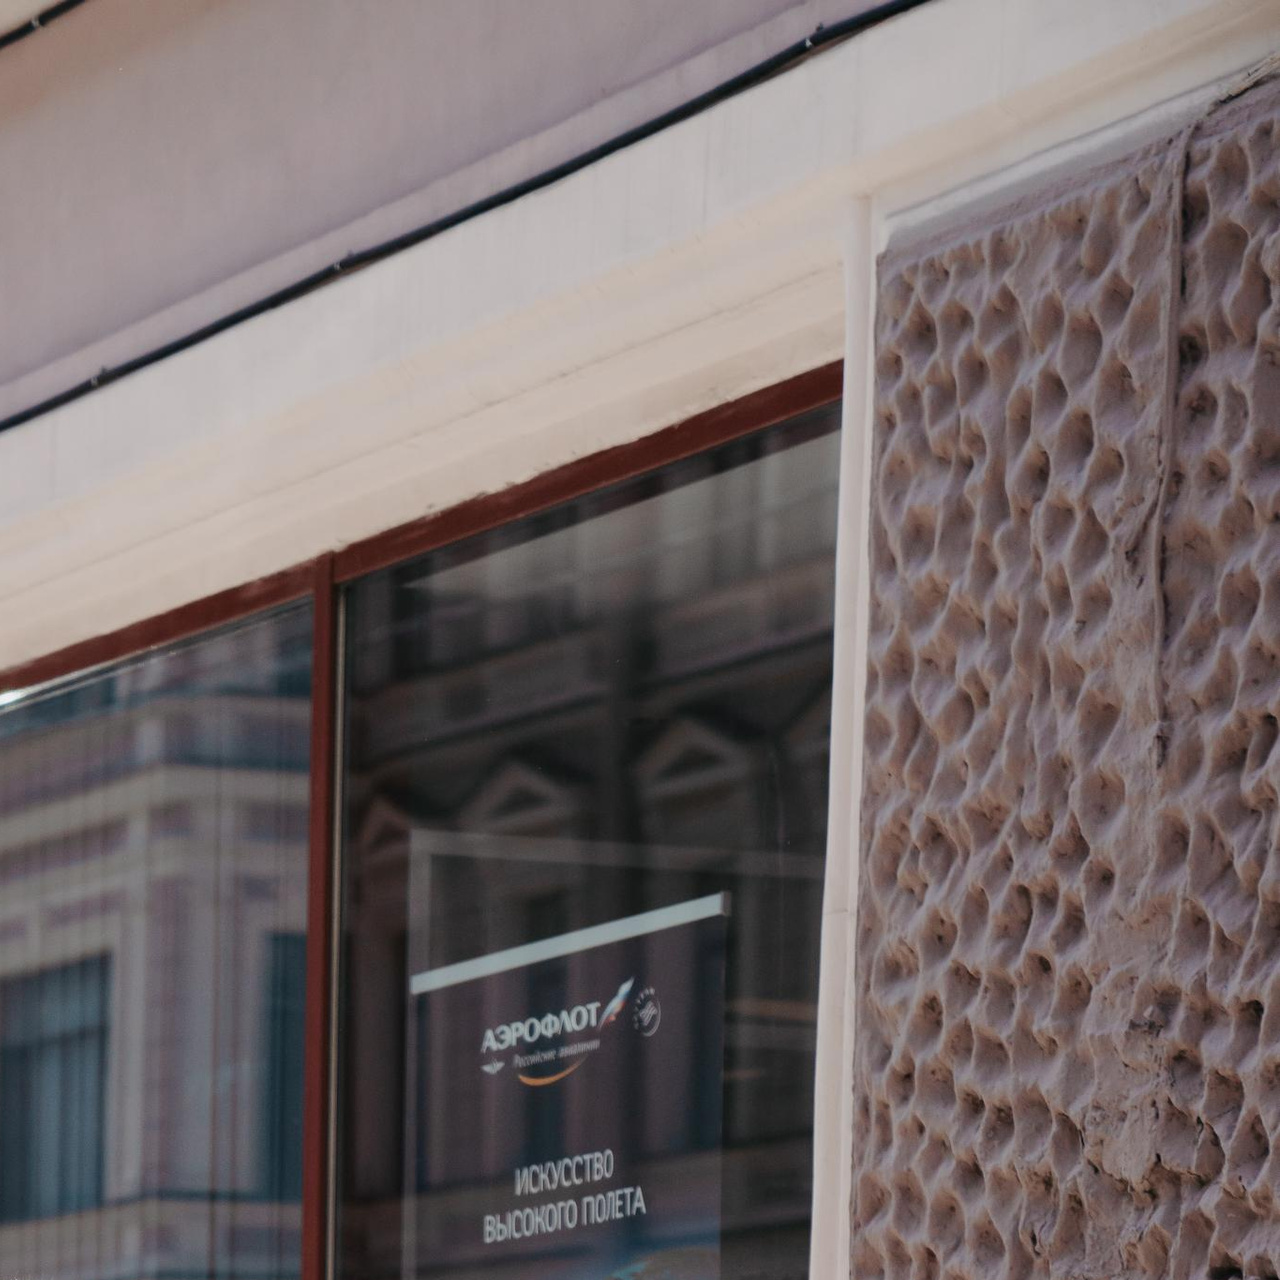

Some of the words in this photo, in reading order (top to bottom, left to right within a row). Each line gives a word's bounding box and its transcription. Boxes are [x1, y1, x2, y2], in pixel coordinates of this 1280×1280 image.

[481, 1001, 601, 1053] АЭРОФЛОТ
[514, 1149, 614, 1195] ИСКУССТВО
[483, 1199, 578, 1243] ВЫСОКОГО
[582, 1186, 646, 1228] ПОЛЕТА
